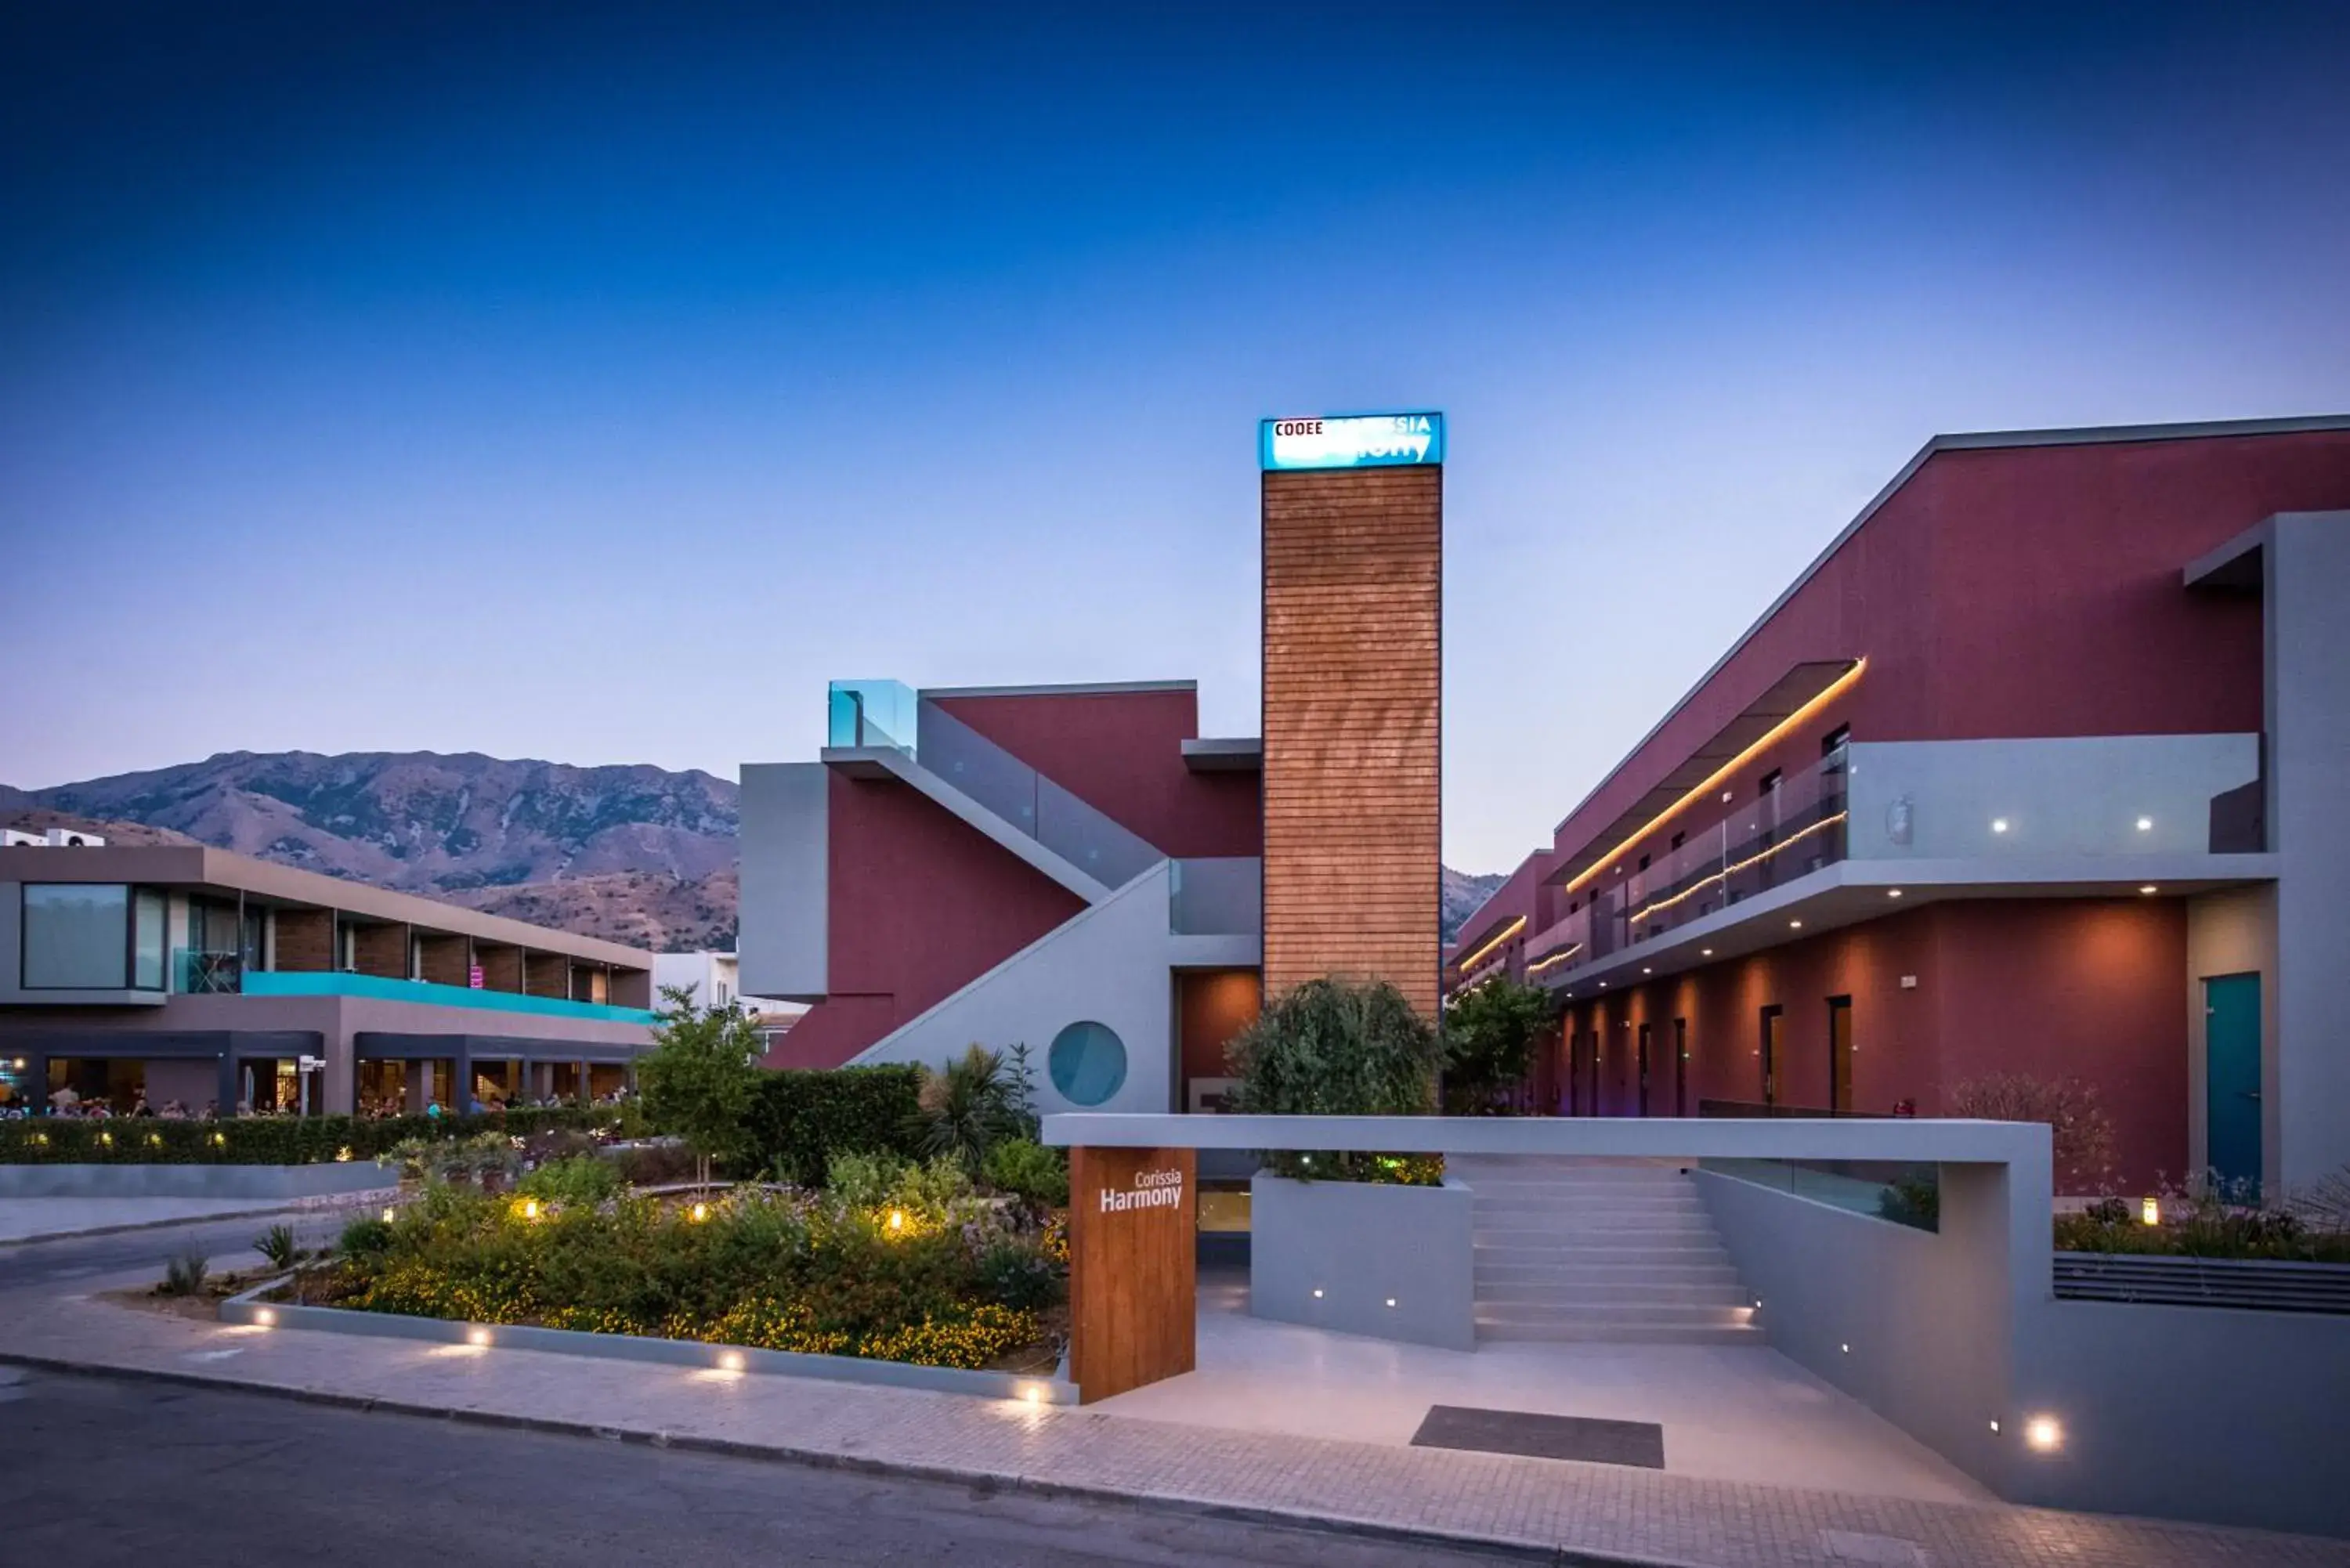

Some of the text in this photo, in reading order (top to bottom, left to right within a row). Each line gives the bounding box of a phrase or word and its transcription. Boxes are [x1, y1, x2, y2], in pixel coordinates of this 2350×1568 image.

[1275, 421, 1323, 436] COOEE
[1135, 1169, 1181, 1188] Corissia
[1101, 1186, 1181, 1212] Harmony
